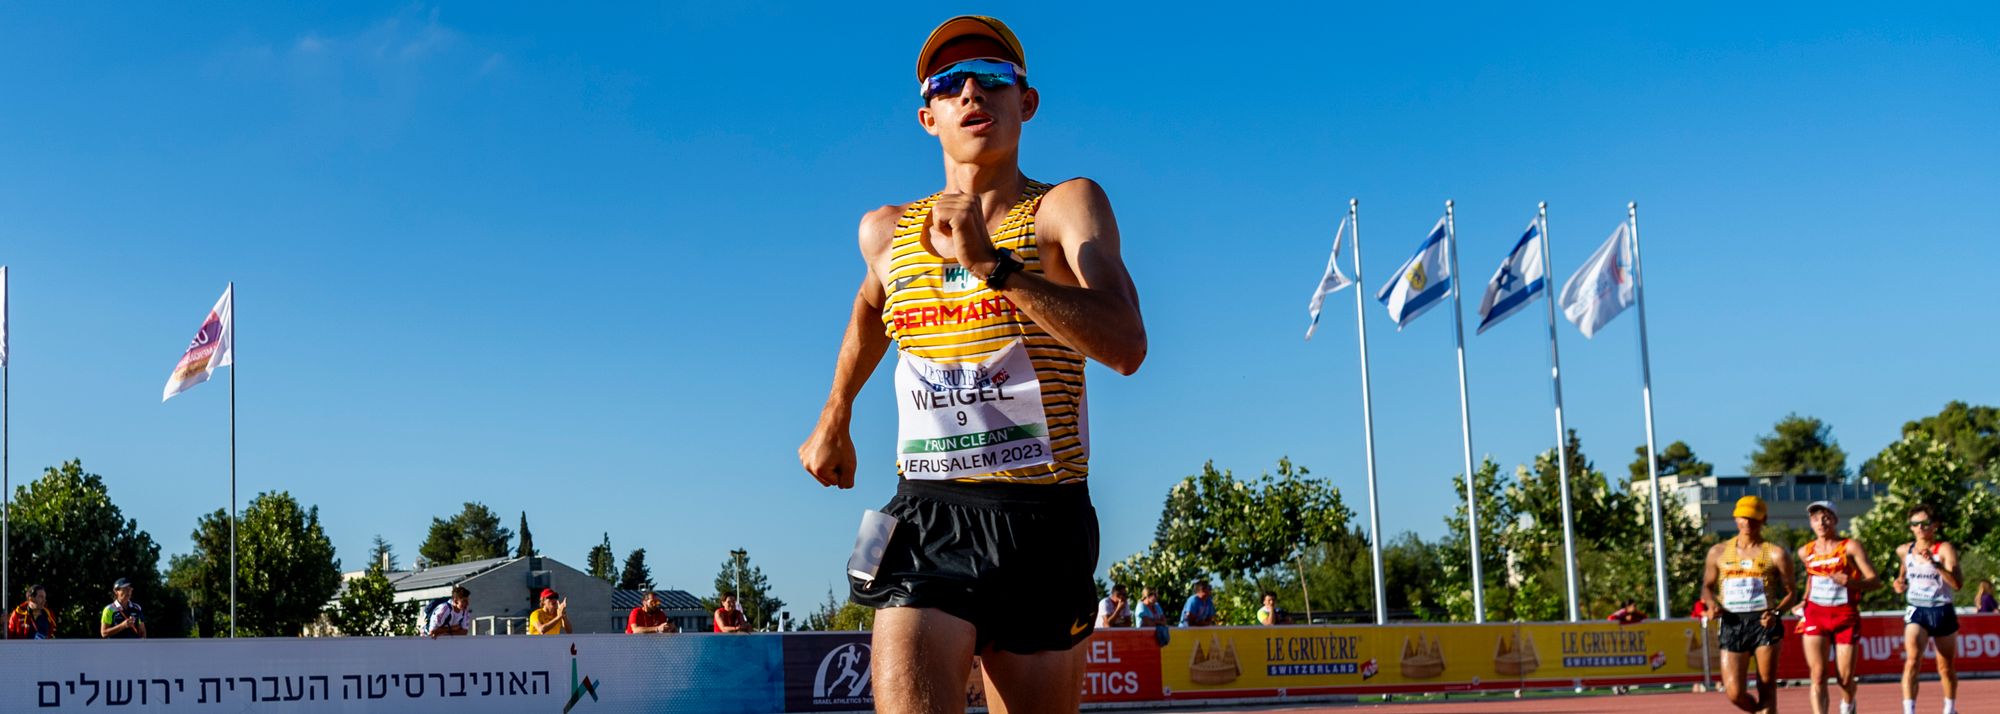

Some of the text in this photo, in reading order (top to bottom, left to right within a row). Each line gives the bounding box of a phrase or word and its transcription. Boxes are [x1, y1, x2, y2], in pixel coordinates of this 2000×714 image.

[893, 295, 1017, 331] GERMANY
[911, 387, 1014, 411] WEIGEL
[956, 410, 968, 426] 9
[931, 437, 957, 451] RUN
[904, 443, 1043, 473] JERUSALEM 2023
[1265, 632, 1358, 661] LE GRUYÈRE
[1561, 627, 1646, 654] LE GRUYÈRE
[1271, 664, 1355, 674] SWITZERLAND
[1565, 656, 1644, 666] SWITZERLAND
[37, 671, 550, 708] האוניברסיטה העברית ירושלים
